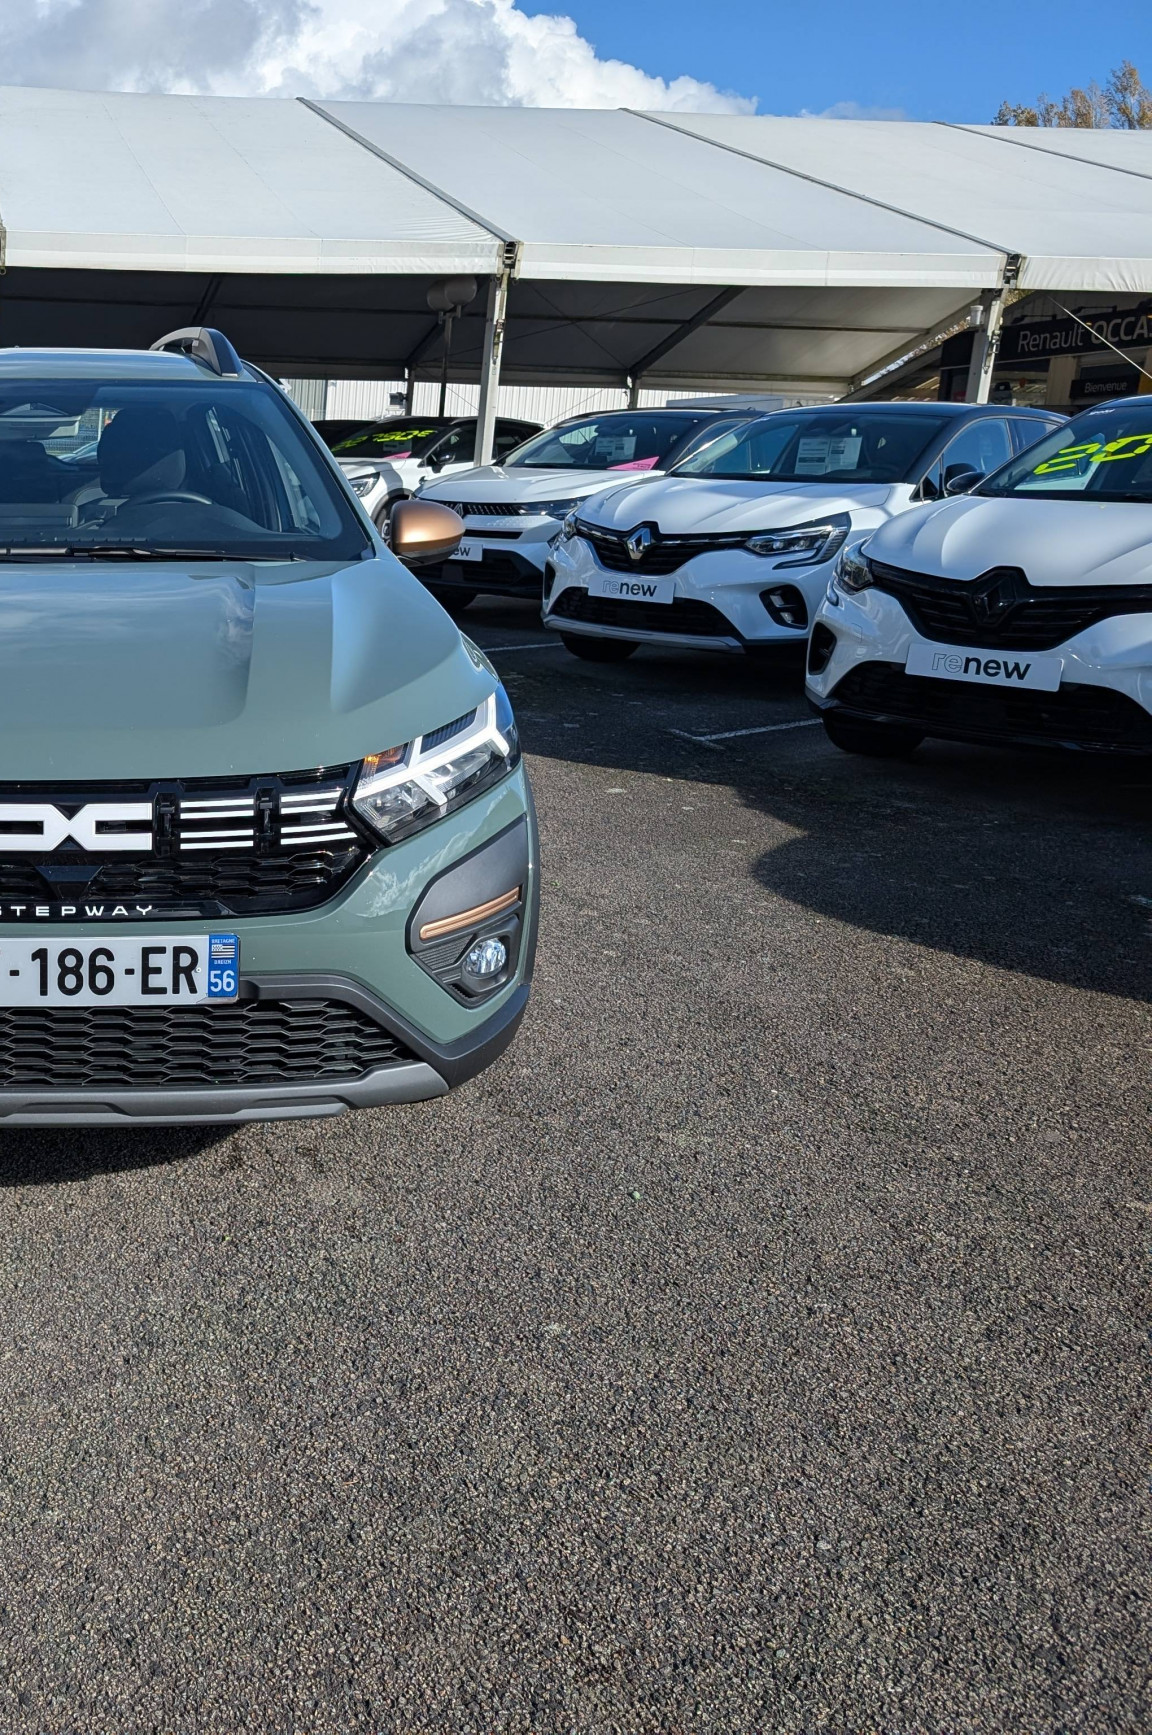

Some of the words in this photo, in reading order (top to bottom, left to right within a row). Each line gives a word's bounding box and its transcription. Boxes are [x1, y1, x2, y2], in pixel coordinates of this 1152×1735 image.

[1018, 323, 1085, 352] Renault
[1091, 315, 1152, 344] OCCA
[1085, 382, 1127, 393] Bienvenue
[602, 580, 657, 597] renew
[931, 652, 1032, 680] renew
[210, 970, 235, 992] 56
